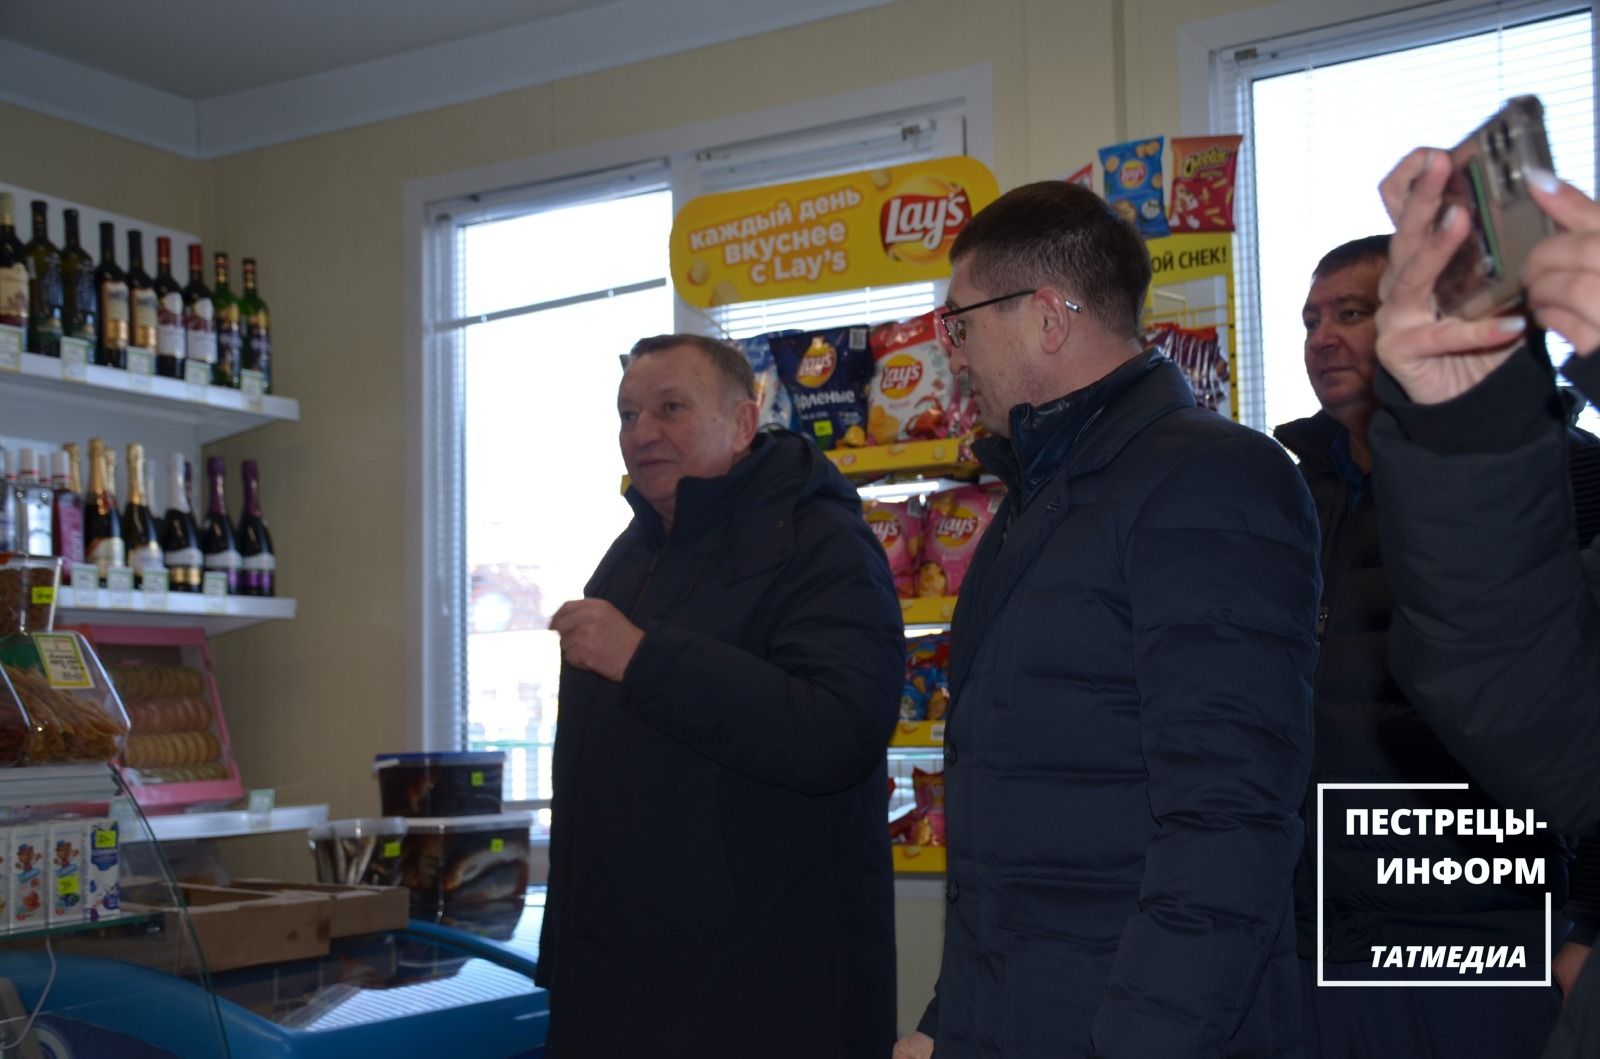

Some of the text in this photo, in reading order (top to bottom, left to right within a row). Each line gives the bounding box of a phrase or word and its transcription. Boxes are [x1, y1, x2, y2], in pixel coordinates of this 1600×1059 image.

[689, 188, 862, 250] каждый день
[885, 190, 966, 250] Lay's
[724, 221, 847, 265] вкуснее
[1151, 246, 1227, 274] ОЙ СНЕК!
[774, 250, 847, 281] Lay's
[869, 520, 899, 542] ay's
